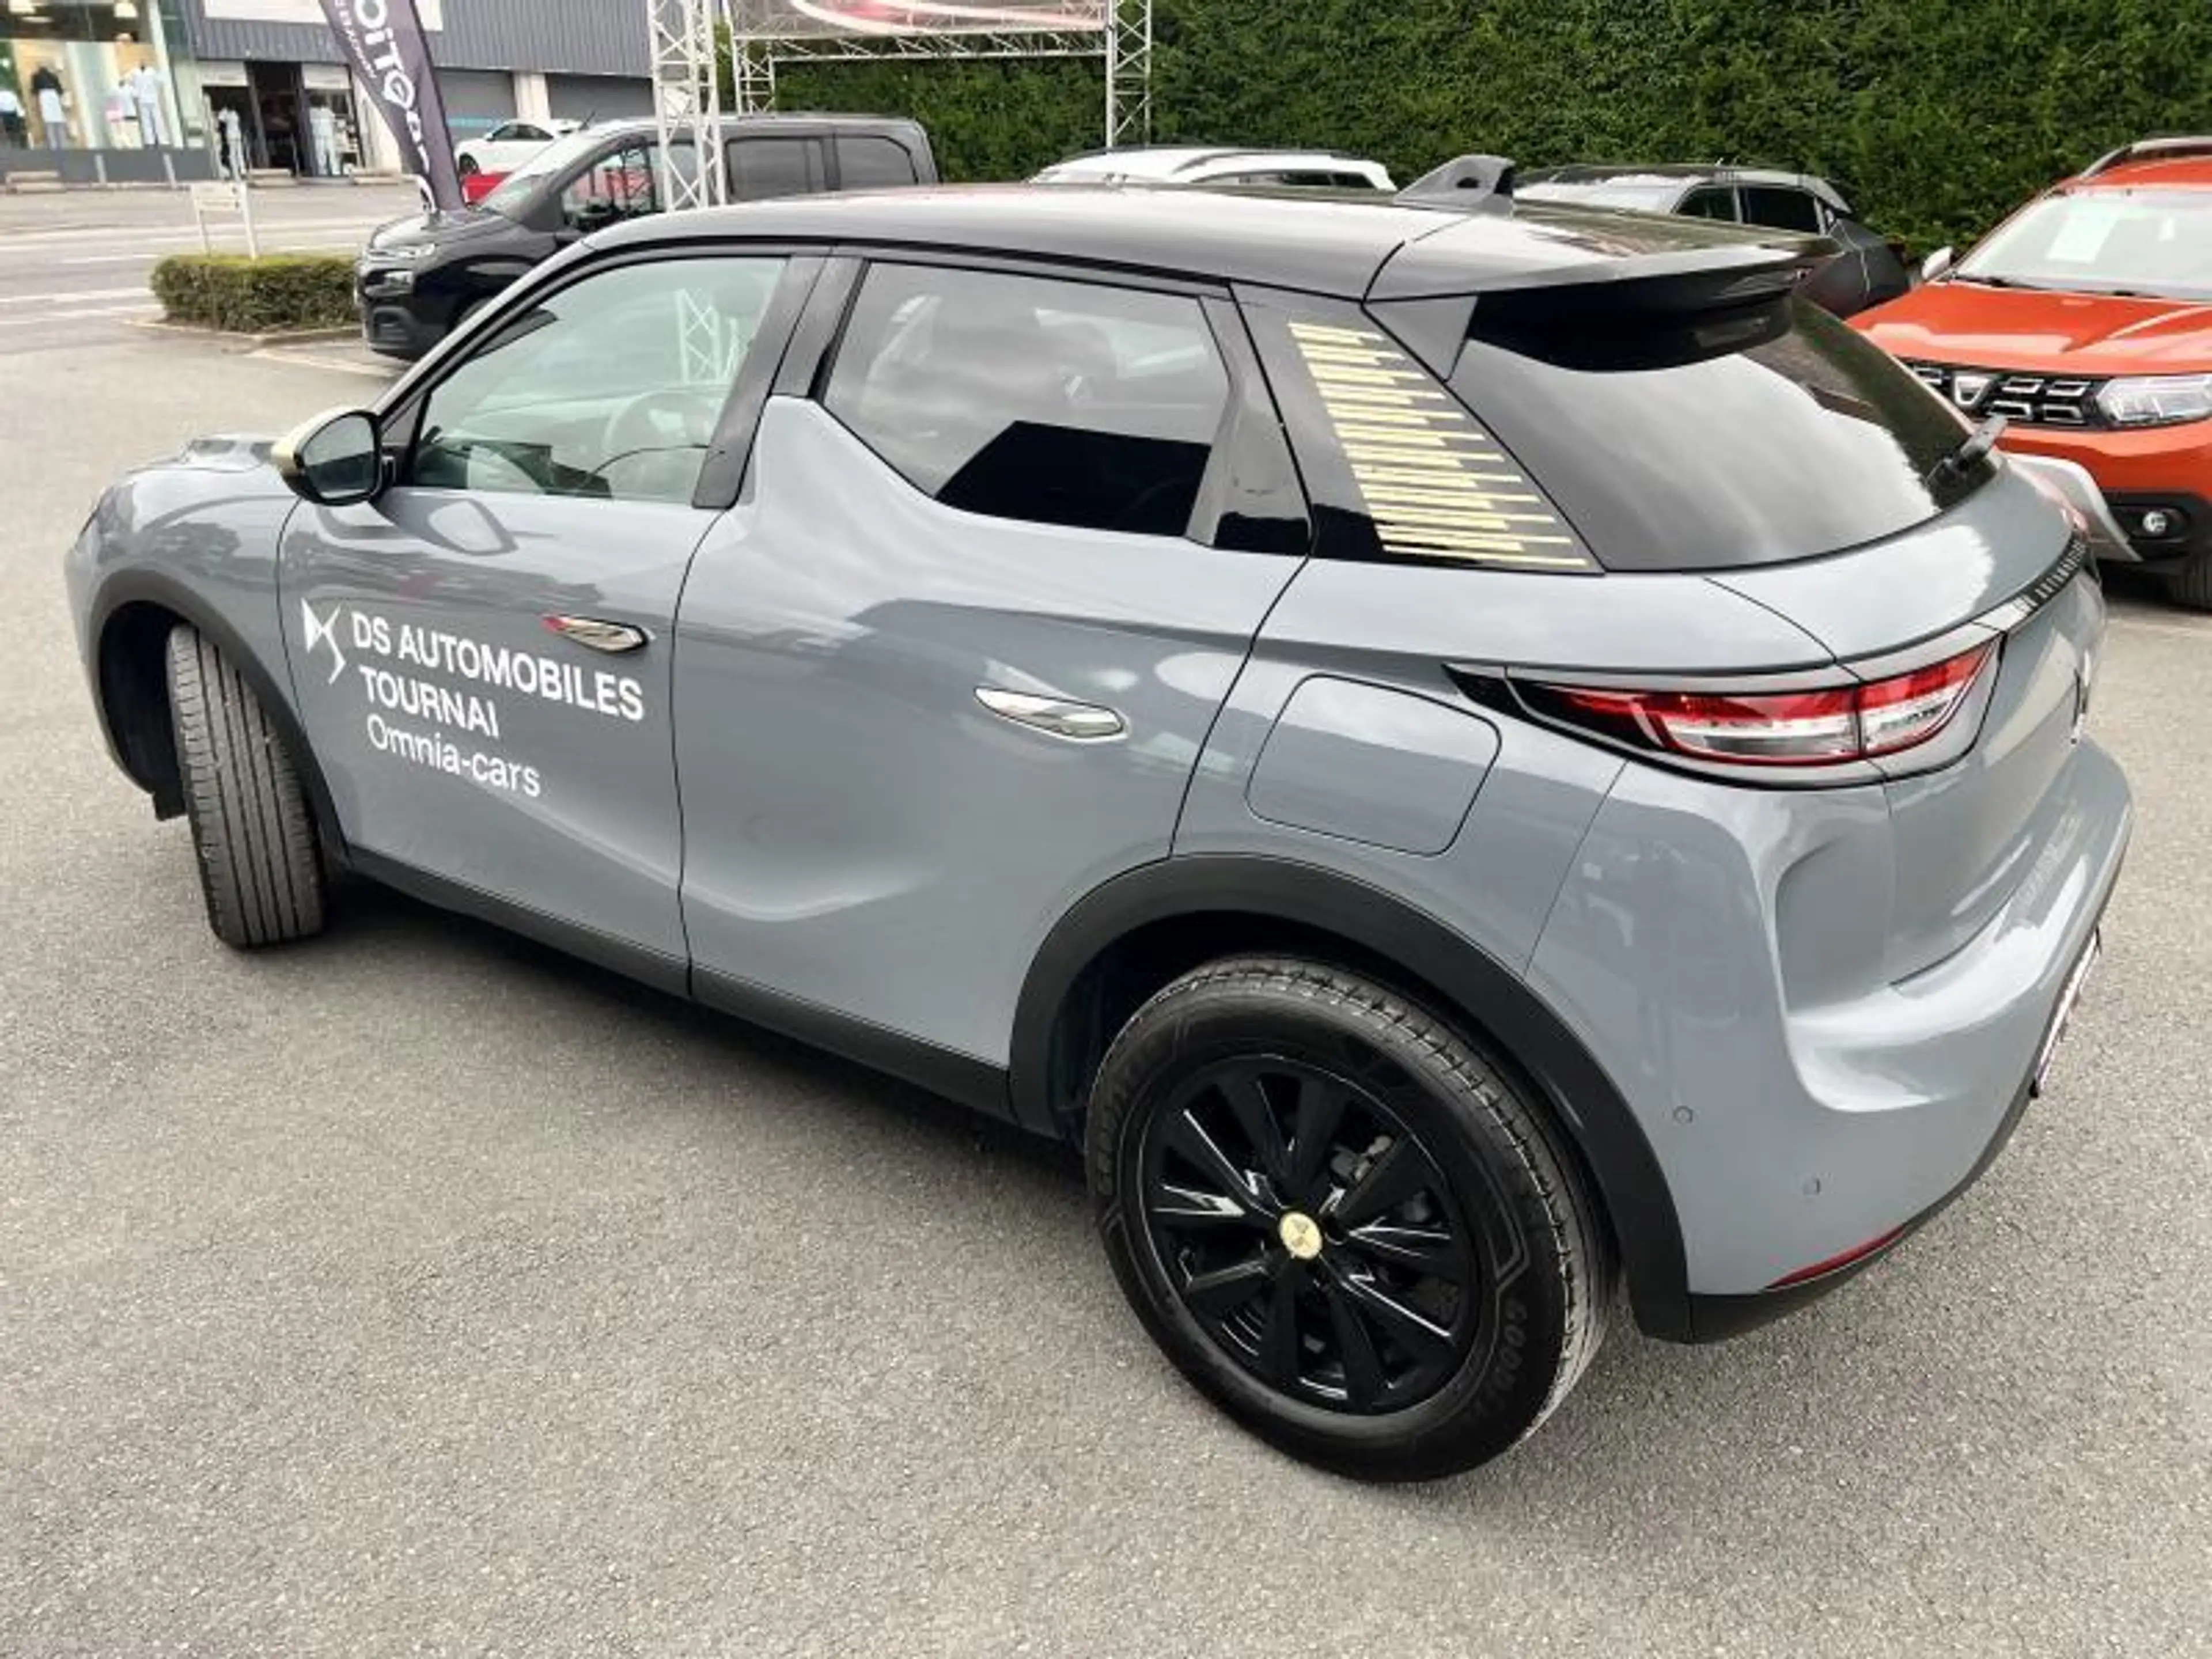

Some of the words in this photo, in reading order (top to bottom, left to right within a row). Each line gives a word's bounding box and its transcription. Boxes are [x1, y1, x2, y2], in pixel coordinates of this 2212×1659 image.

[351, 611, 391, 655] DS
[397, 624, 645, 722] AUTOMOBILES
[359, 665, 499, 738] TOURNAI
[367, 714, 540, 798] Omnia-cars
